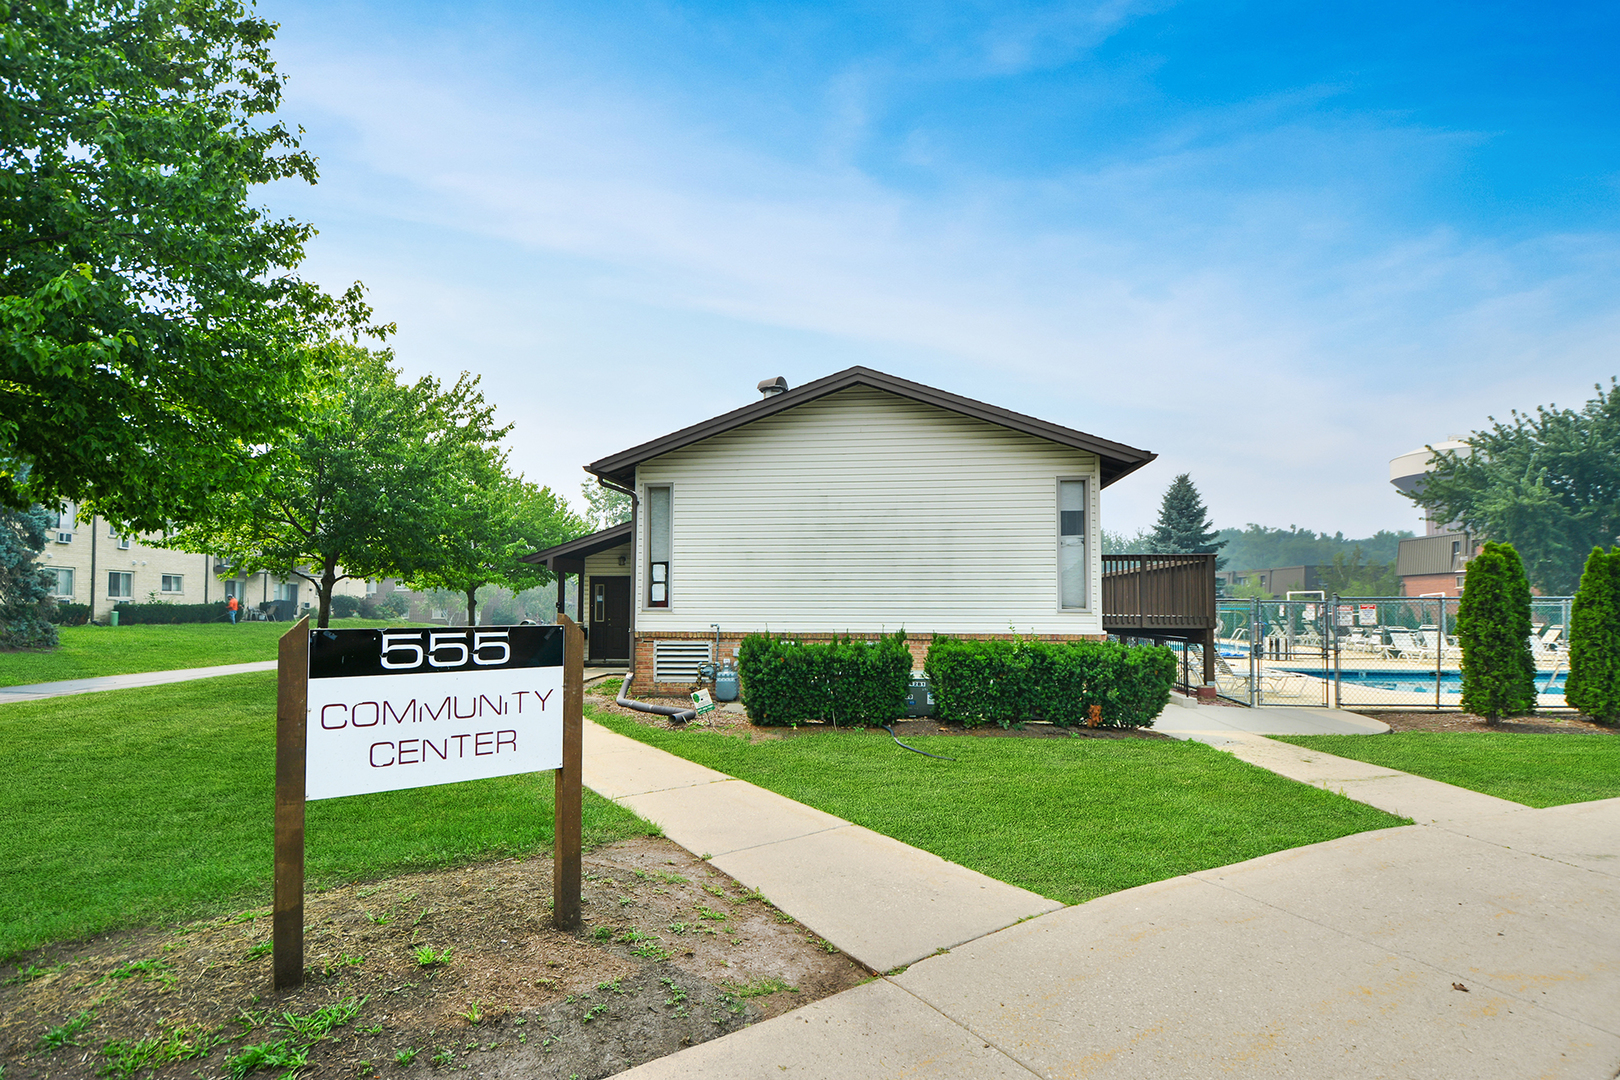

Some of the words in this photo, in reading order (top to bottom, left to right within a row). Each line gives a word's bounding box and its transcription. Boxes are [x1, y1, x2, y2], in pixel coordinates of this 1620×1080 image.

[380, 631, 511, 669] 555
[320, 688, 554, 730] COMMUNITY
[369, 729, 517, 768] CENTER
